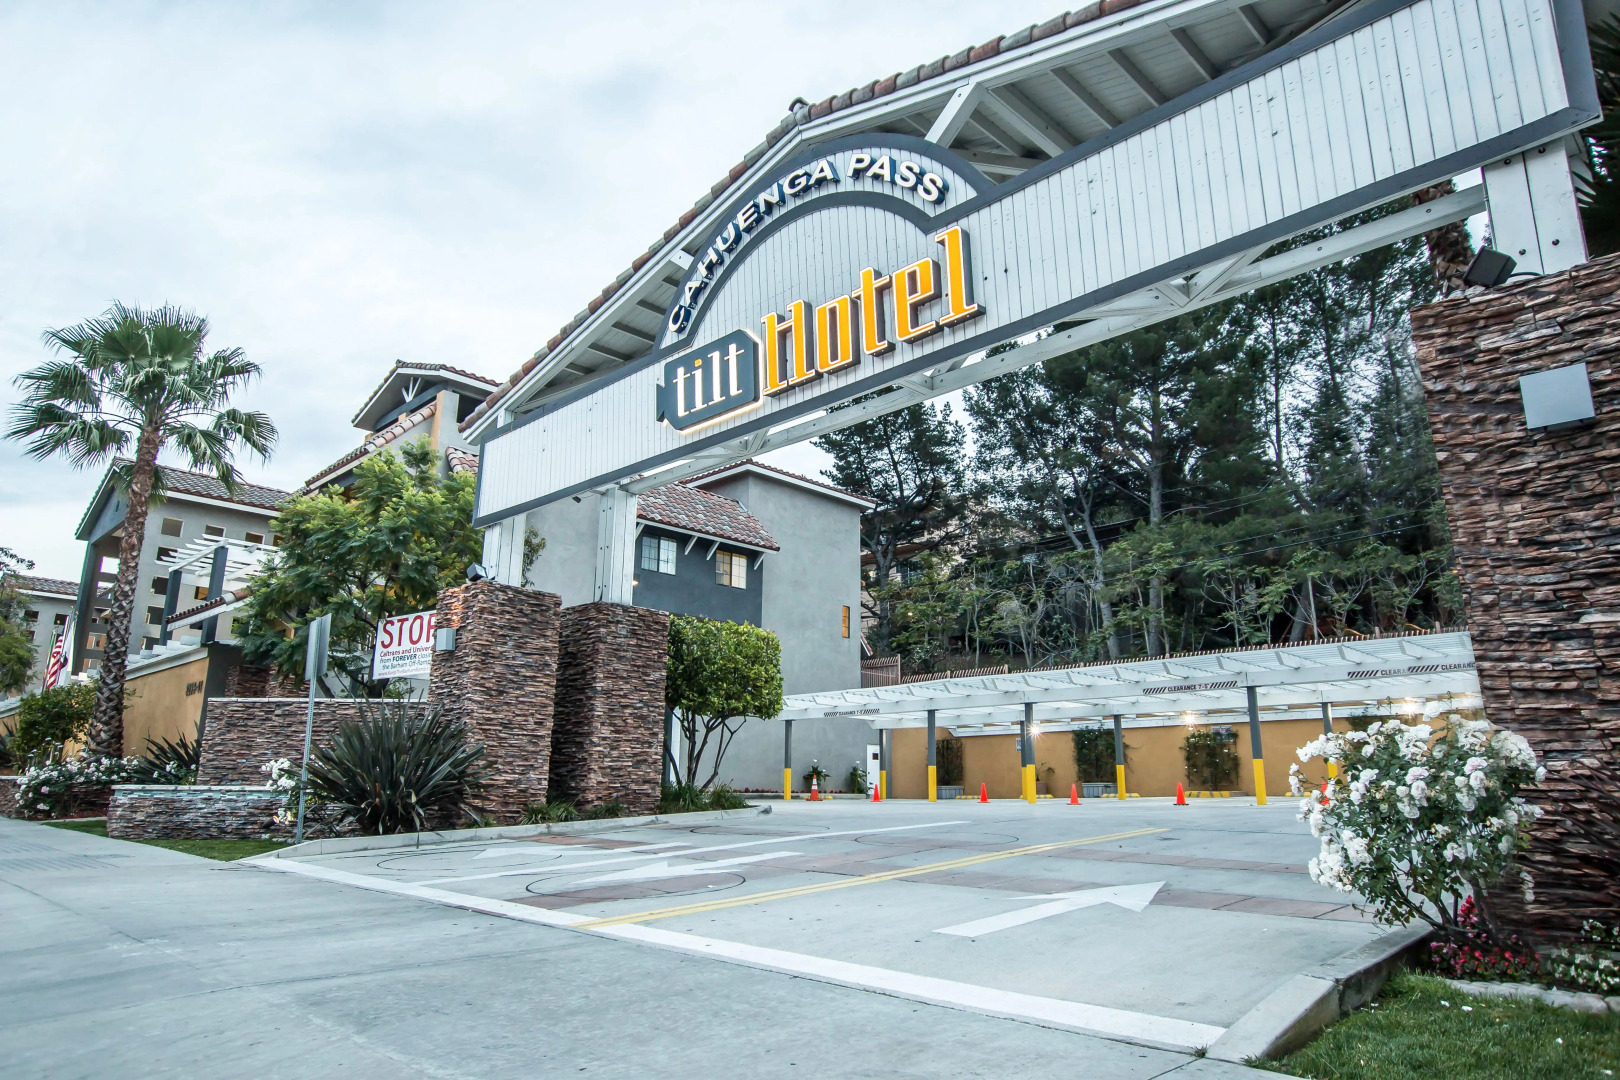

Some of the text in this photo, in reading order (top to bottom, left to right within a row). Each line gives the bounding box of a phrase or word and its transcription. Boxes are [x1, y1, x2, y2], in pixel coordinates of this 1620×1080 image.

[668, 153, 948, 333] CAHUENGA PASS
[673, 343, 744, 418] tilt
[392, 653, 417, 662] FOREVER
[1167, 684, 1197, 692] CLEARANCE
